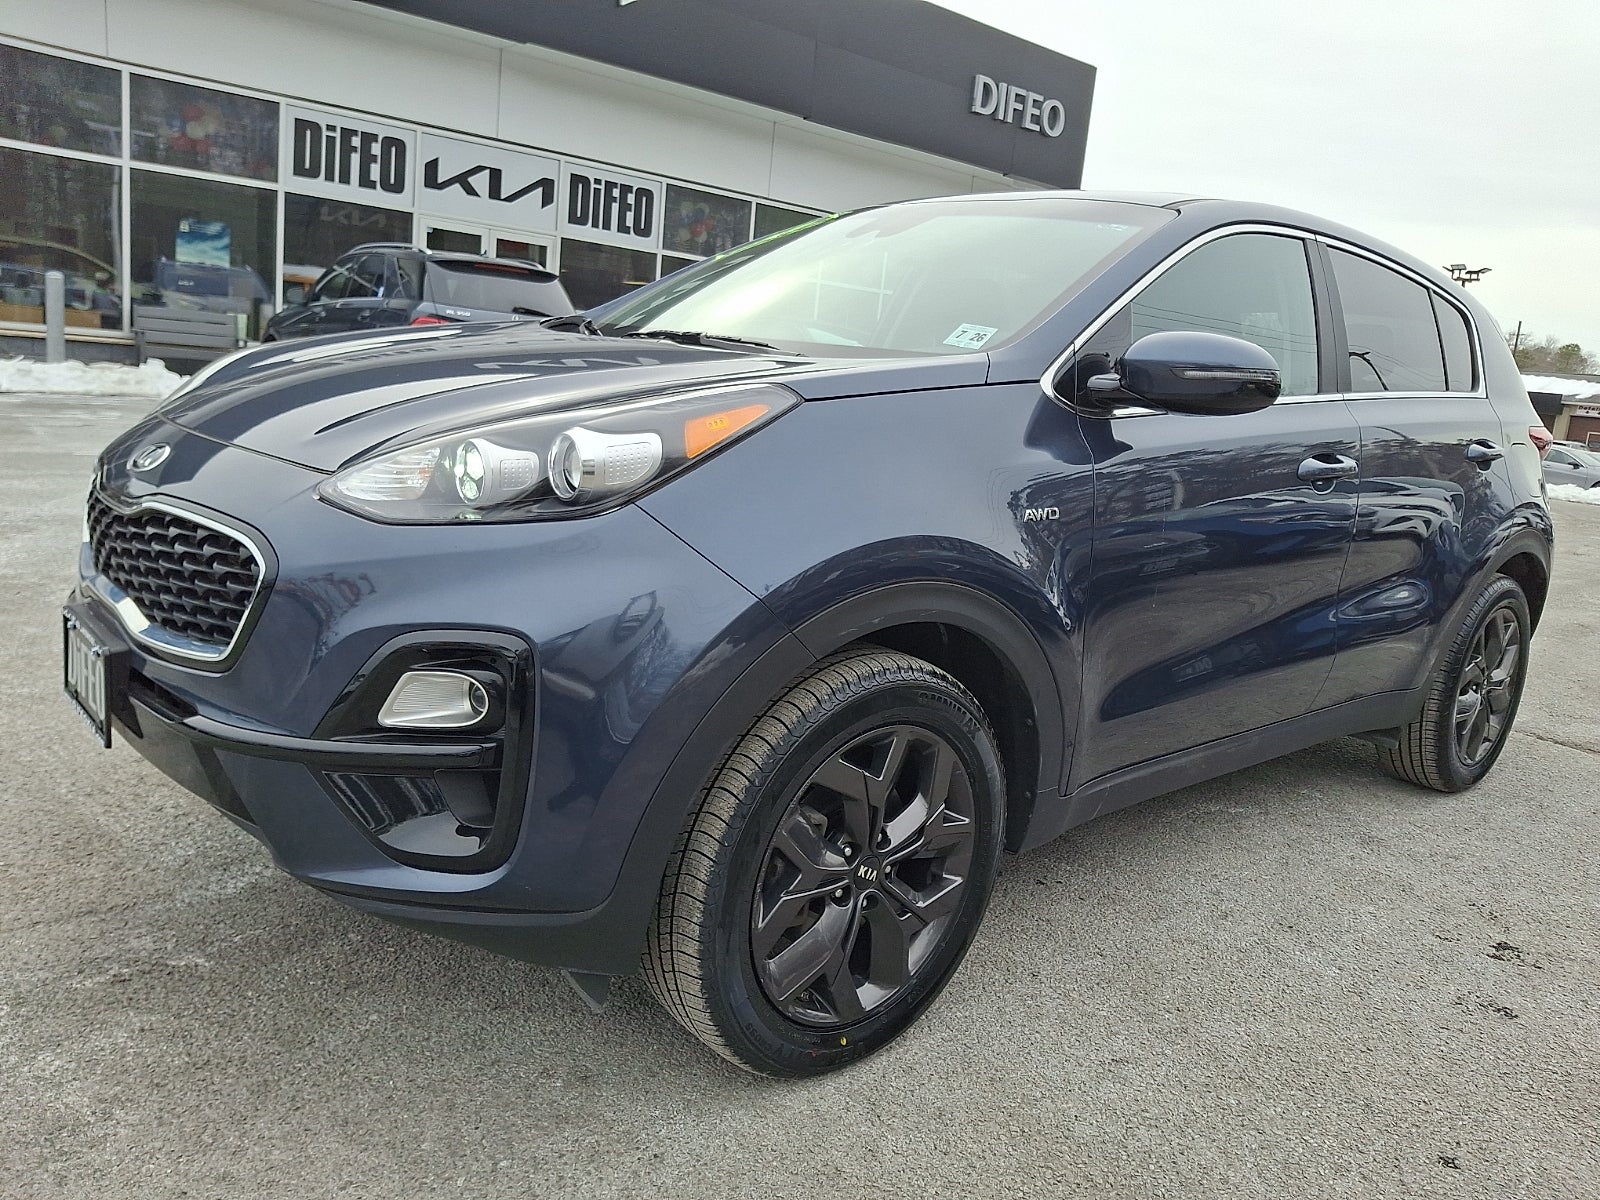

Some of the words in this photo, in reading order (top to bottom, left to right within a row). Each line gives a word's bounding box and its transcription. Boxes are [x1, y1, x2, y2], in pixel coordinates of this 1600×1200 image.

[971, 74, 1066, 137] DIFEO
[424, 156, 556, 210] KIA
[955, 330, 968, 338] 7
[969, 333, 987, 342] 26
[1023, 507, 1060, 522] AWD
[857, 864, 878, 882] KIA
